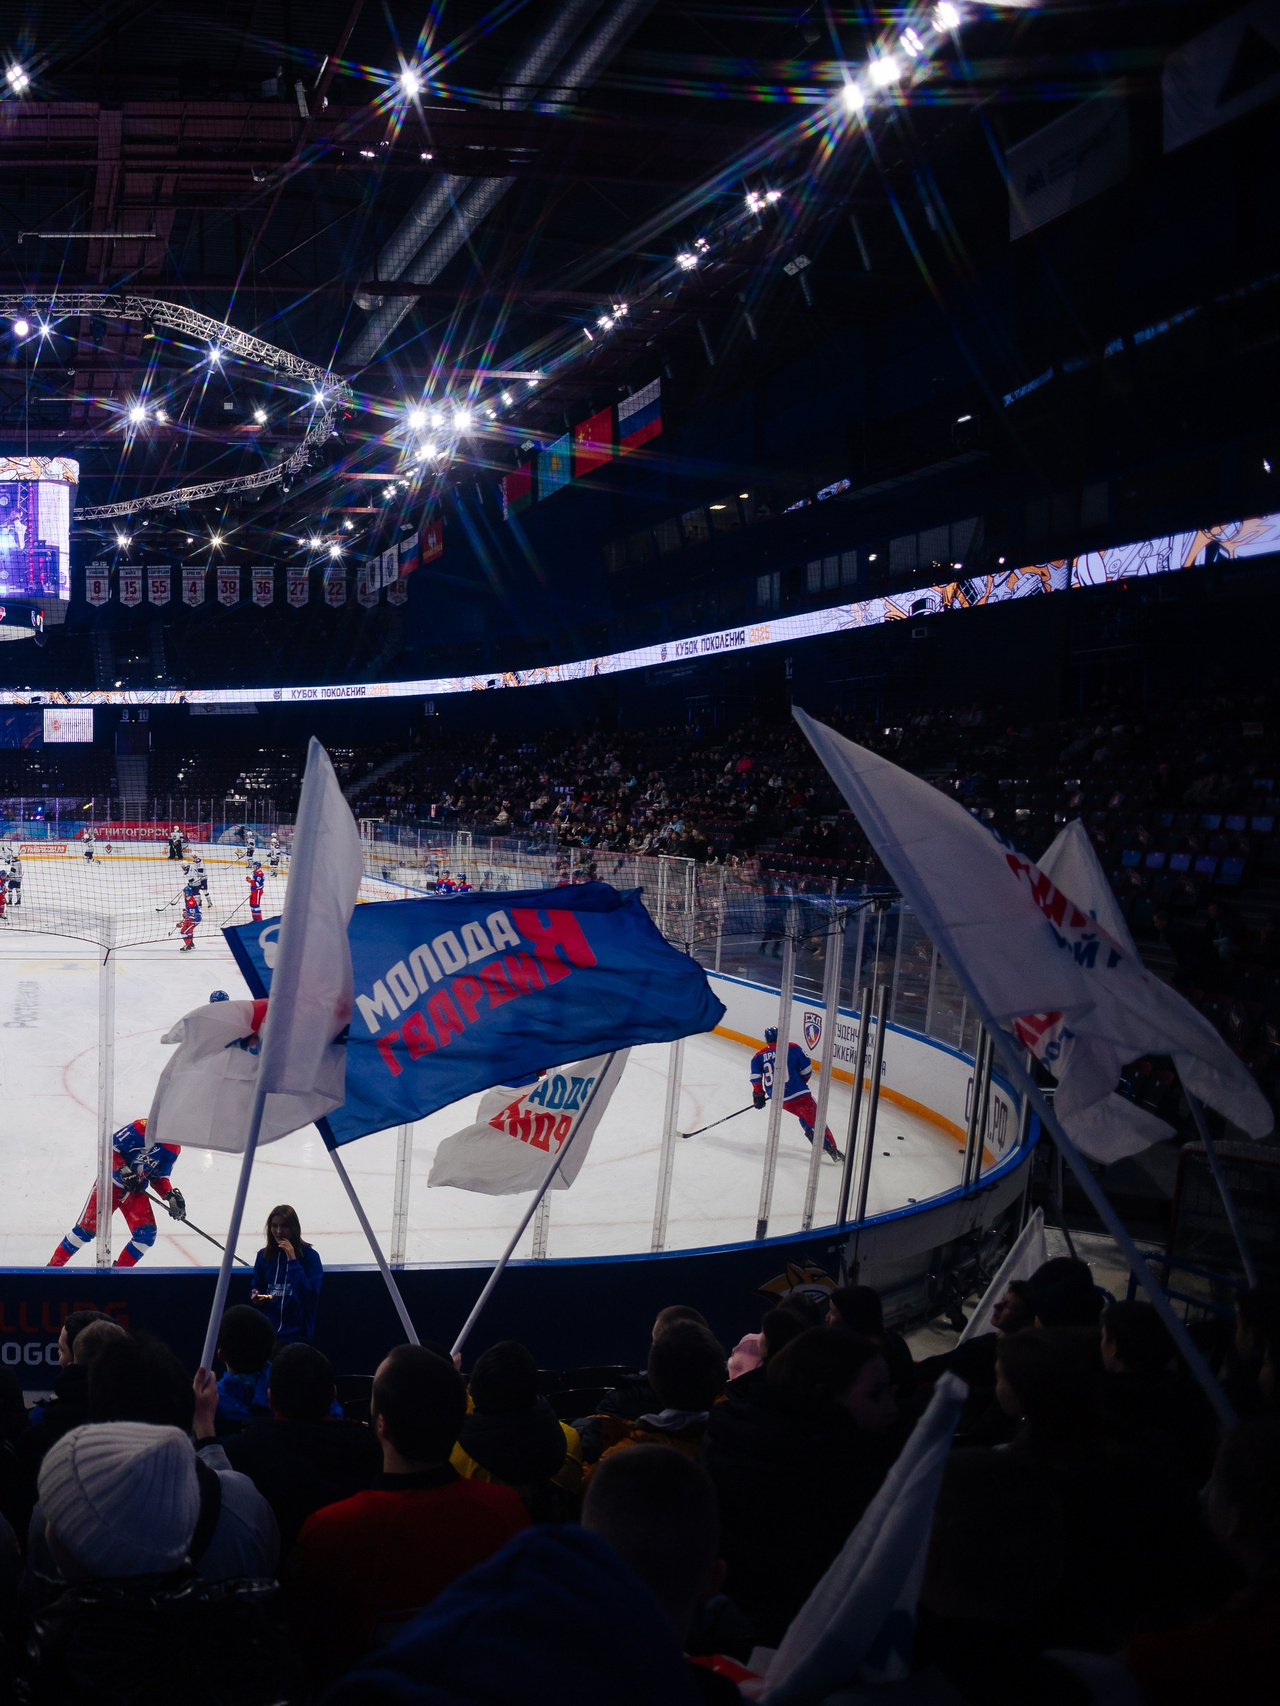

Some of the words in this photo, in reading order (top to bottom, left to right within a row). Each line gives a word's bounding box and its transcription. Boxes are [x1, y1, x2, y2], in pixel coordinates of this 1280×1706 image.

[125, 581, 137, 594] 15
[152, 581, 167, 594] 55
[189, 581, 197, 594] 4
[291, 582, 305, 595] 27
[328, 582, 342, 595] 22
[675, 640, 698, 657] КУБОК
[701, 630, 745, 653] ПОКОЛЕНИЯ
[291, 689, 318, 699] КУБОК
[321, 686, 366, 698] ПОКОЛЕНИЯ
[83, 826, 168, 838] МАГНИТОГОРСК
